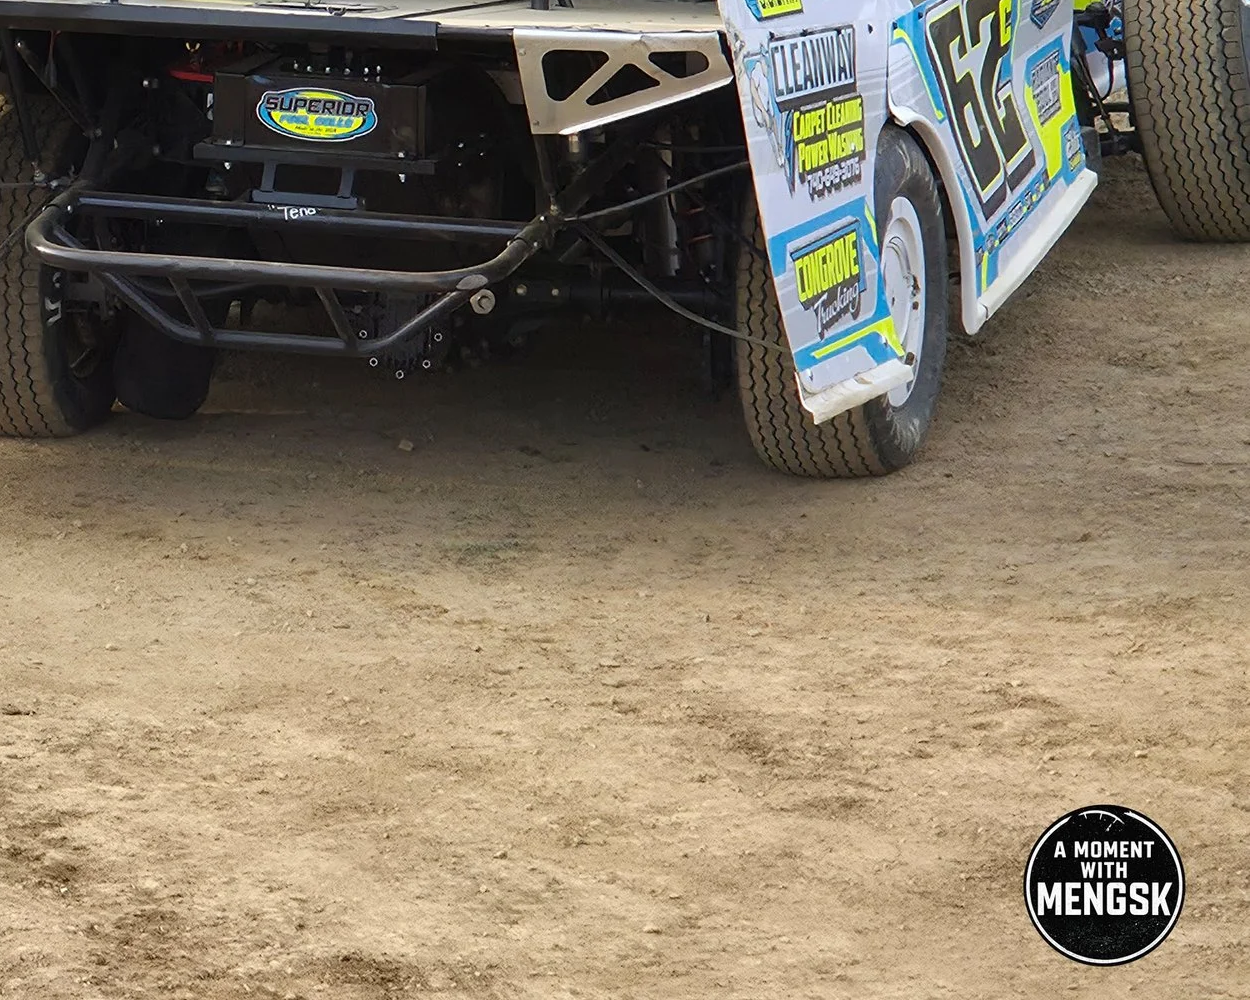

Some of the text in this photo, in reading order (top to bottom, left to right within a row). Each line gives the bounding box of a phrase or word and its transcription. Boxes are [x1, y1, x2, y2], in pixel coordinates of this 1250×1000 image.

[770, 27, 855, 97] CLEANWAY
[264, 96, 370, 117] SUPERIOR
[793, 97, 863, 143] CARPET CLEANING
[798, 127, 864, 174] POWER WASHING
[794, 231, 860, 303] CONGROVE
[813, 281, 860, 335] Trucking
